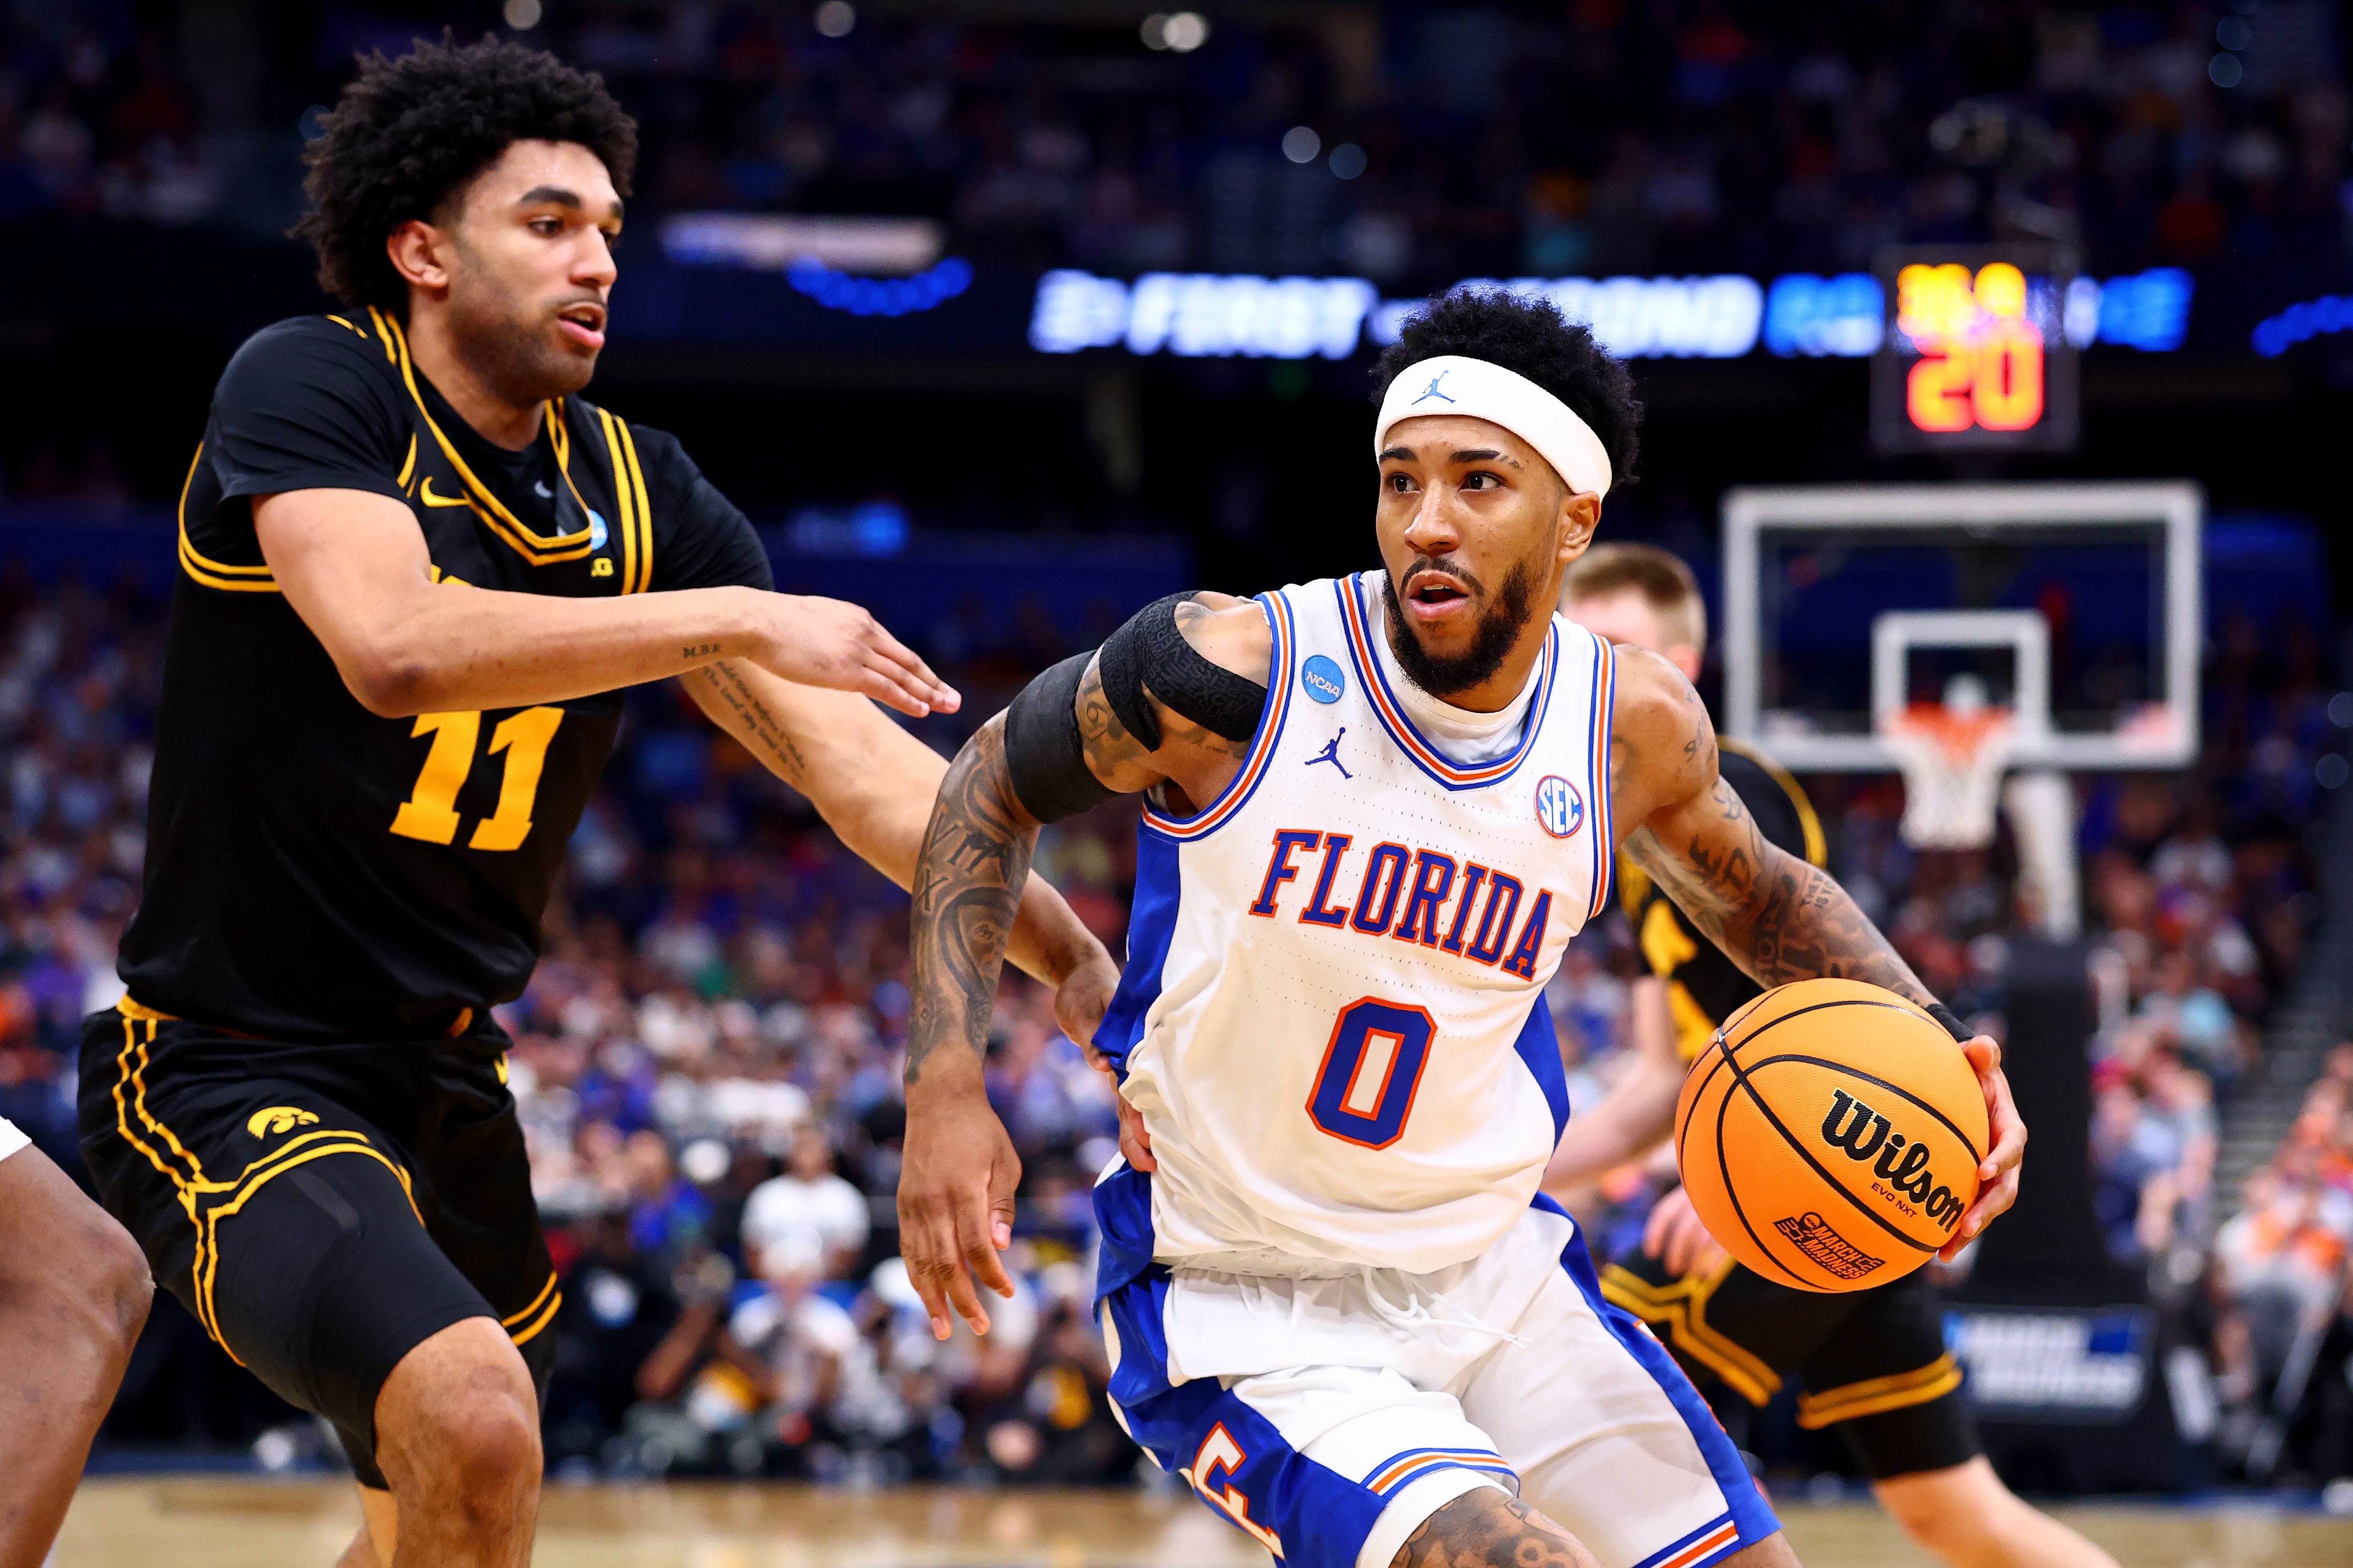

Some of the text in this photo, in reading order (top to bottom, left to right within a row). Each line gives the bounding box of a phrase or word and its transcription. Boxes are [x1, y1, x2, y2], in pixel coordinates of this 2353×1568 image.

[1907, 323, 2043, 432] 20
[1305, 671, 1341, 698] NCAA
[389, 707, 565, 851] 11
[1538, 778, 1580, 834] SEC
[1249, 828, 1552, 981] FLORIDA
[1305, 995, 1437, 1150] 0
[1822, 1088, 1965, 1233] Wilson
[1871, 1182, 1917, 1218] EVO NXT
[1803, 1239, 1864, 1278] MADNESS
[1812, 1225, 1862, 1262] MARCH
